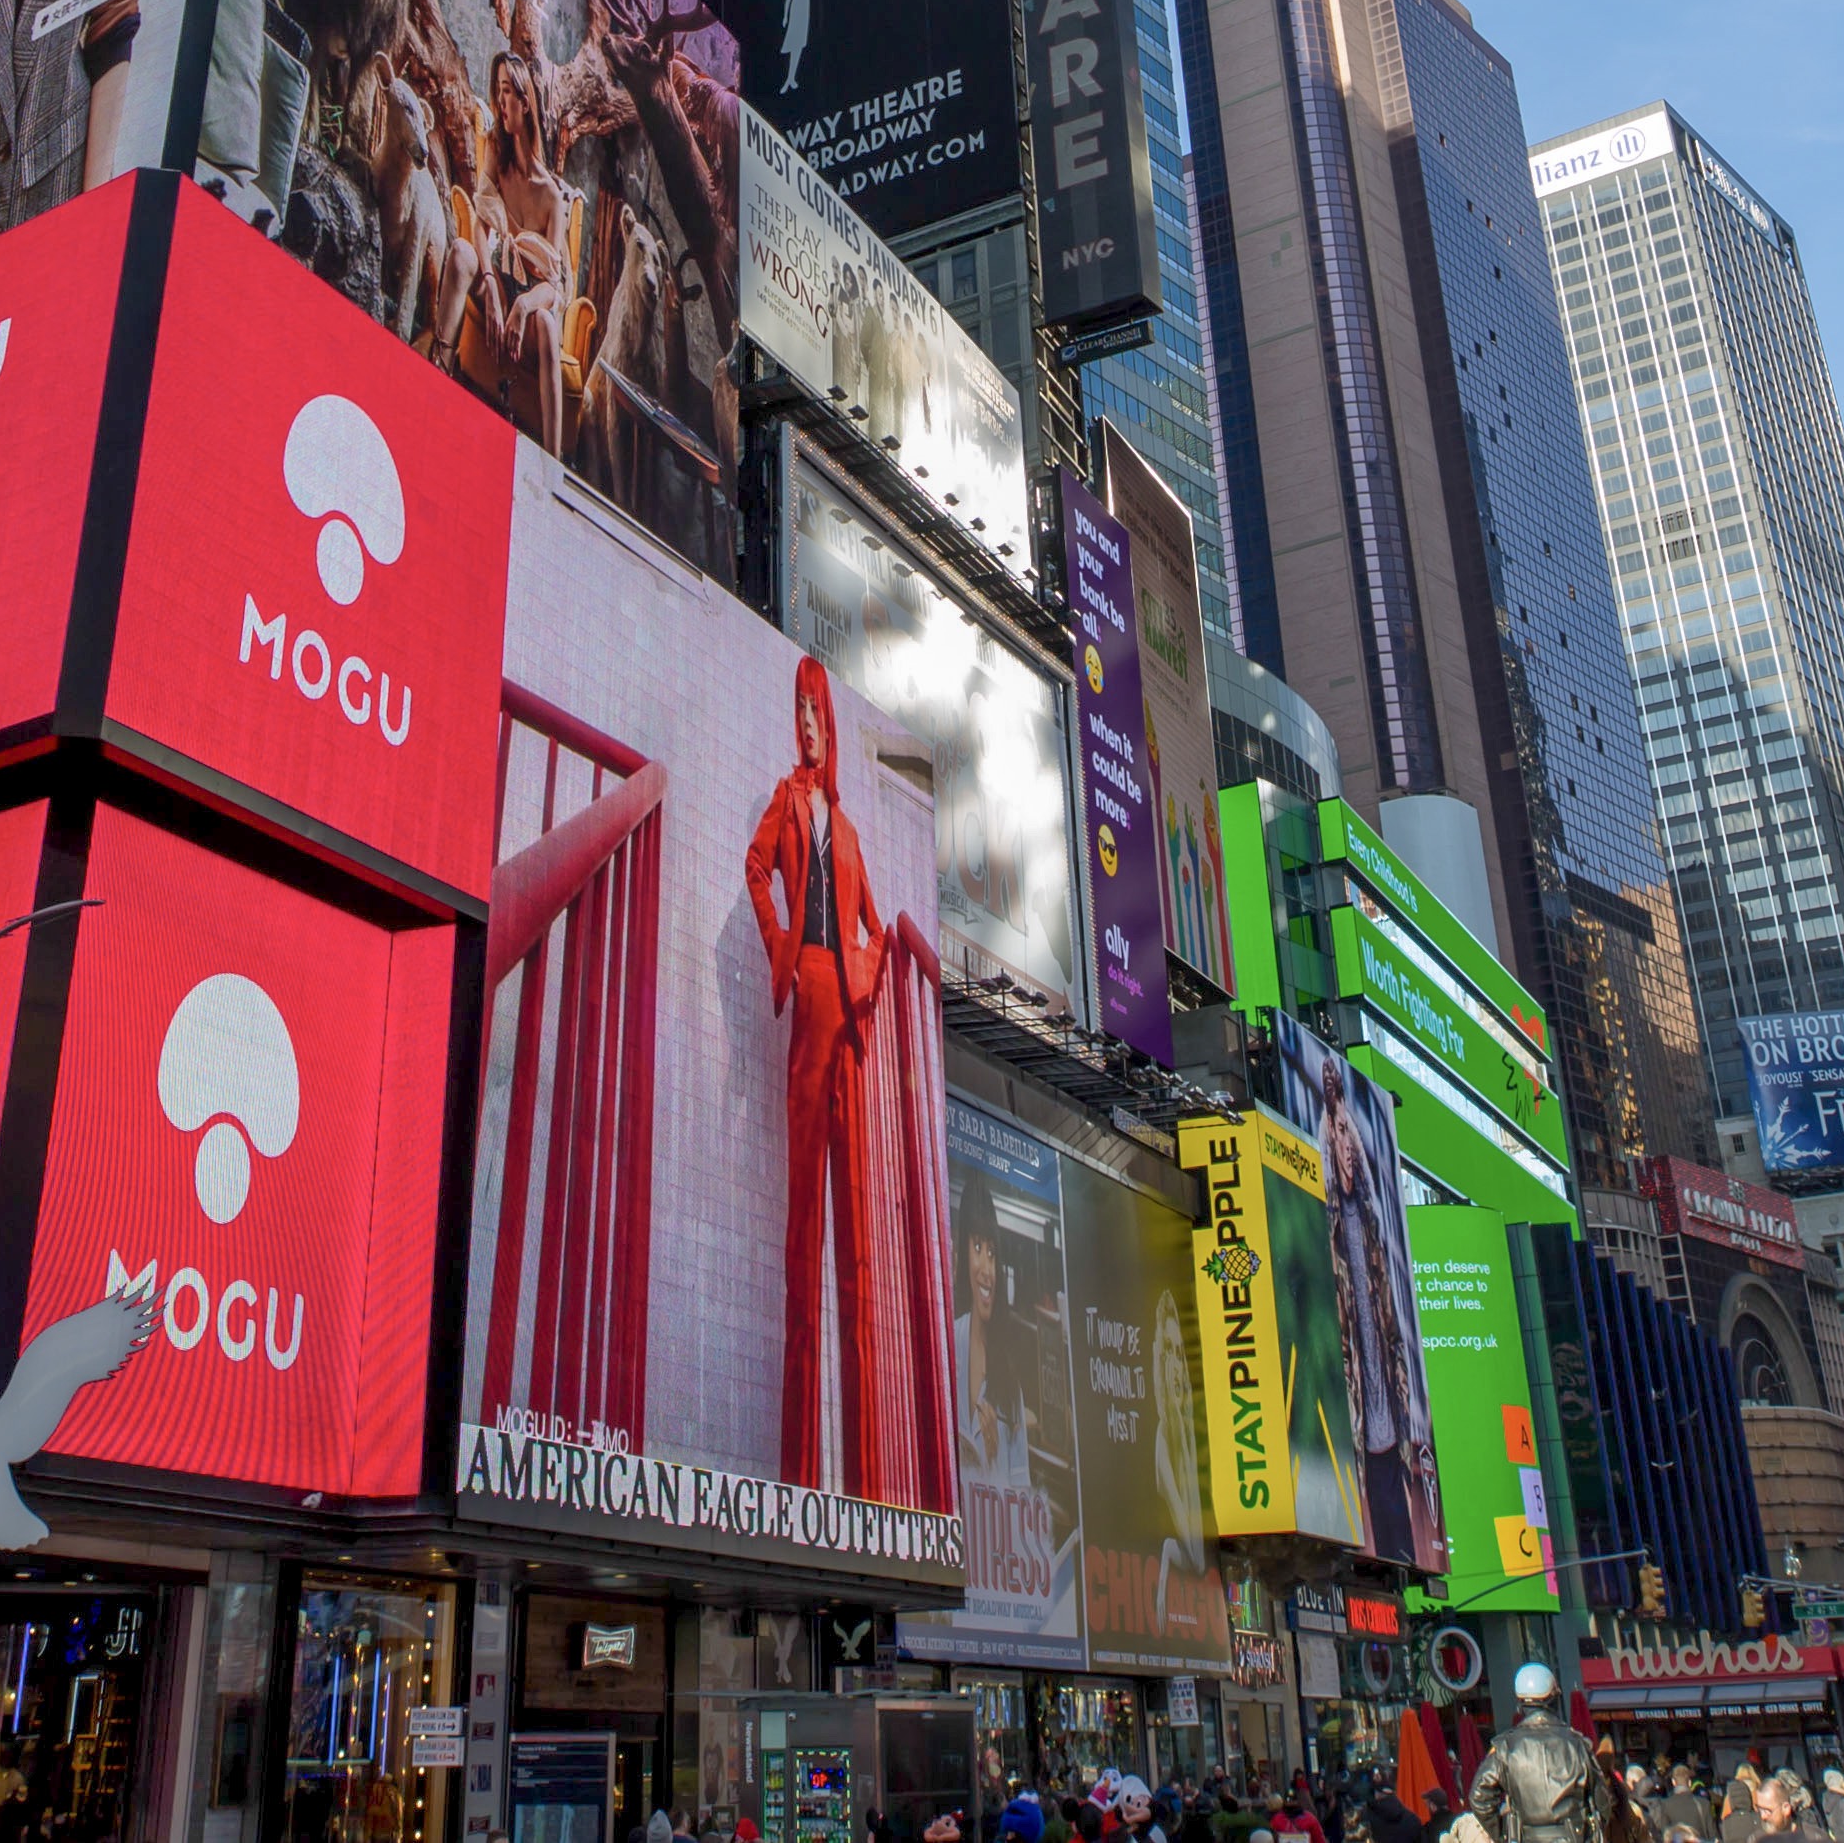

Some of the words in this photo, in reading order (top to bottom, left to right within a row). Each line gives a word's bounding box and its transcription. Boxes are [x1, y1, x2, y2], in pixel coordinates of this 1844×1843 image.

[850, 69, 963, 128] THEATRE
[746, 115, 791, 185] MUST
[797, 166, 861, 255] CLOTHES
[865, 237, 926, 320] JANUARY
[785, 205, 822, 258] PLAY
[786, 237, 829, 298] GOES
[1062, 238, 1114, 270] NYC
[746, 231, 830, 340] WRONG
[1074, 507, 1095, 539] you
[1098, 531, 1120, 567] and
[1076, 541, 1103, 582] your
[1079, 579, 1109, 622] bank
[1110, 601, 1125, 633] be
[239, 593, 412, 746] MOGU
[1089, 713, 1120, 755] when
[1122, 734, 1133, 765] it
[1092, 750, 1125, 796] could
[1126, 775, 1142, 805] be
[1346, 822, 1372, 874] Every
[1105, 924, 1129, 970] ally
[1361, 937, 1397, 1003] Worth
[1399, 974, 1446, 1051] Fighting
[1752, 1040, 1789, 1066] ON
[959, 1112, 987, 1142] SARA
[990, 1124, 1040, 1168] BAREILLES
[1425, 1278, 1474, 1292] chance
[1444, 1259, 1491, 1275] deserve
[1419, 1295, 1450, 1311] their
[1453, 1295, 1485, 1311] lives.
[496, 1404, 546, 1440] MOGU
[550, 1411, 572, 1443] ID:
[463, 1427, 681, 1526] AMERICAN
[693, 1467, 794, 1540] EAGLE
[800, 1490, 965, 1569] OUTFITTERS
[1609, 1628, 1804, 1680] nuchas
